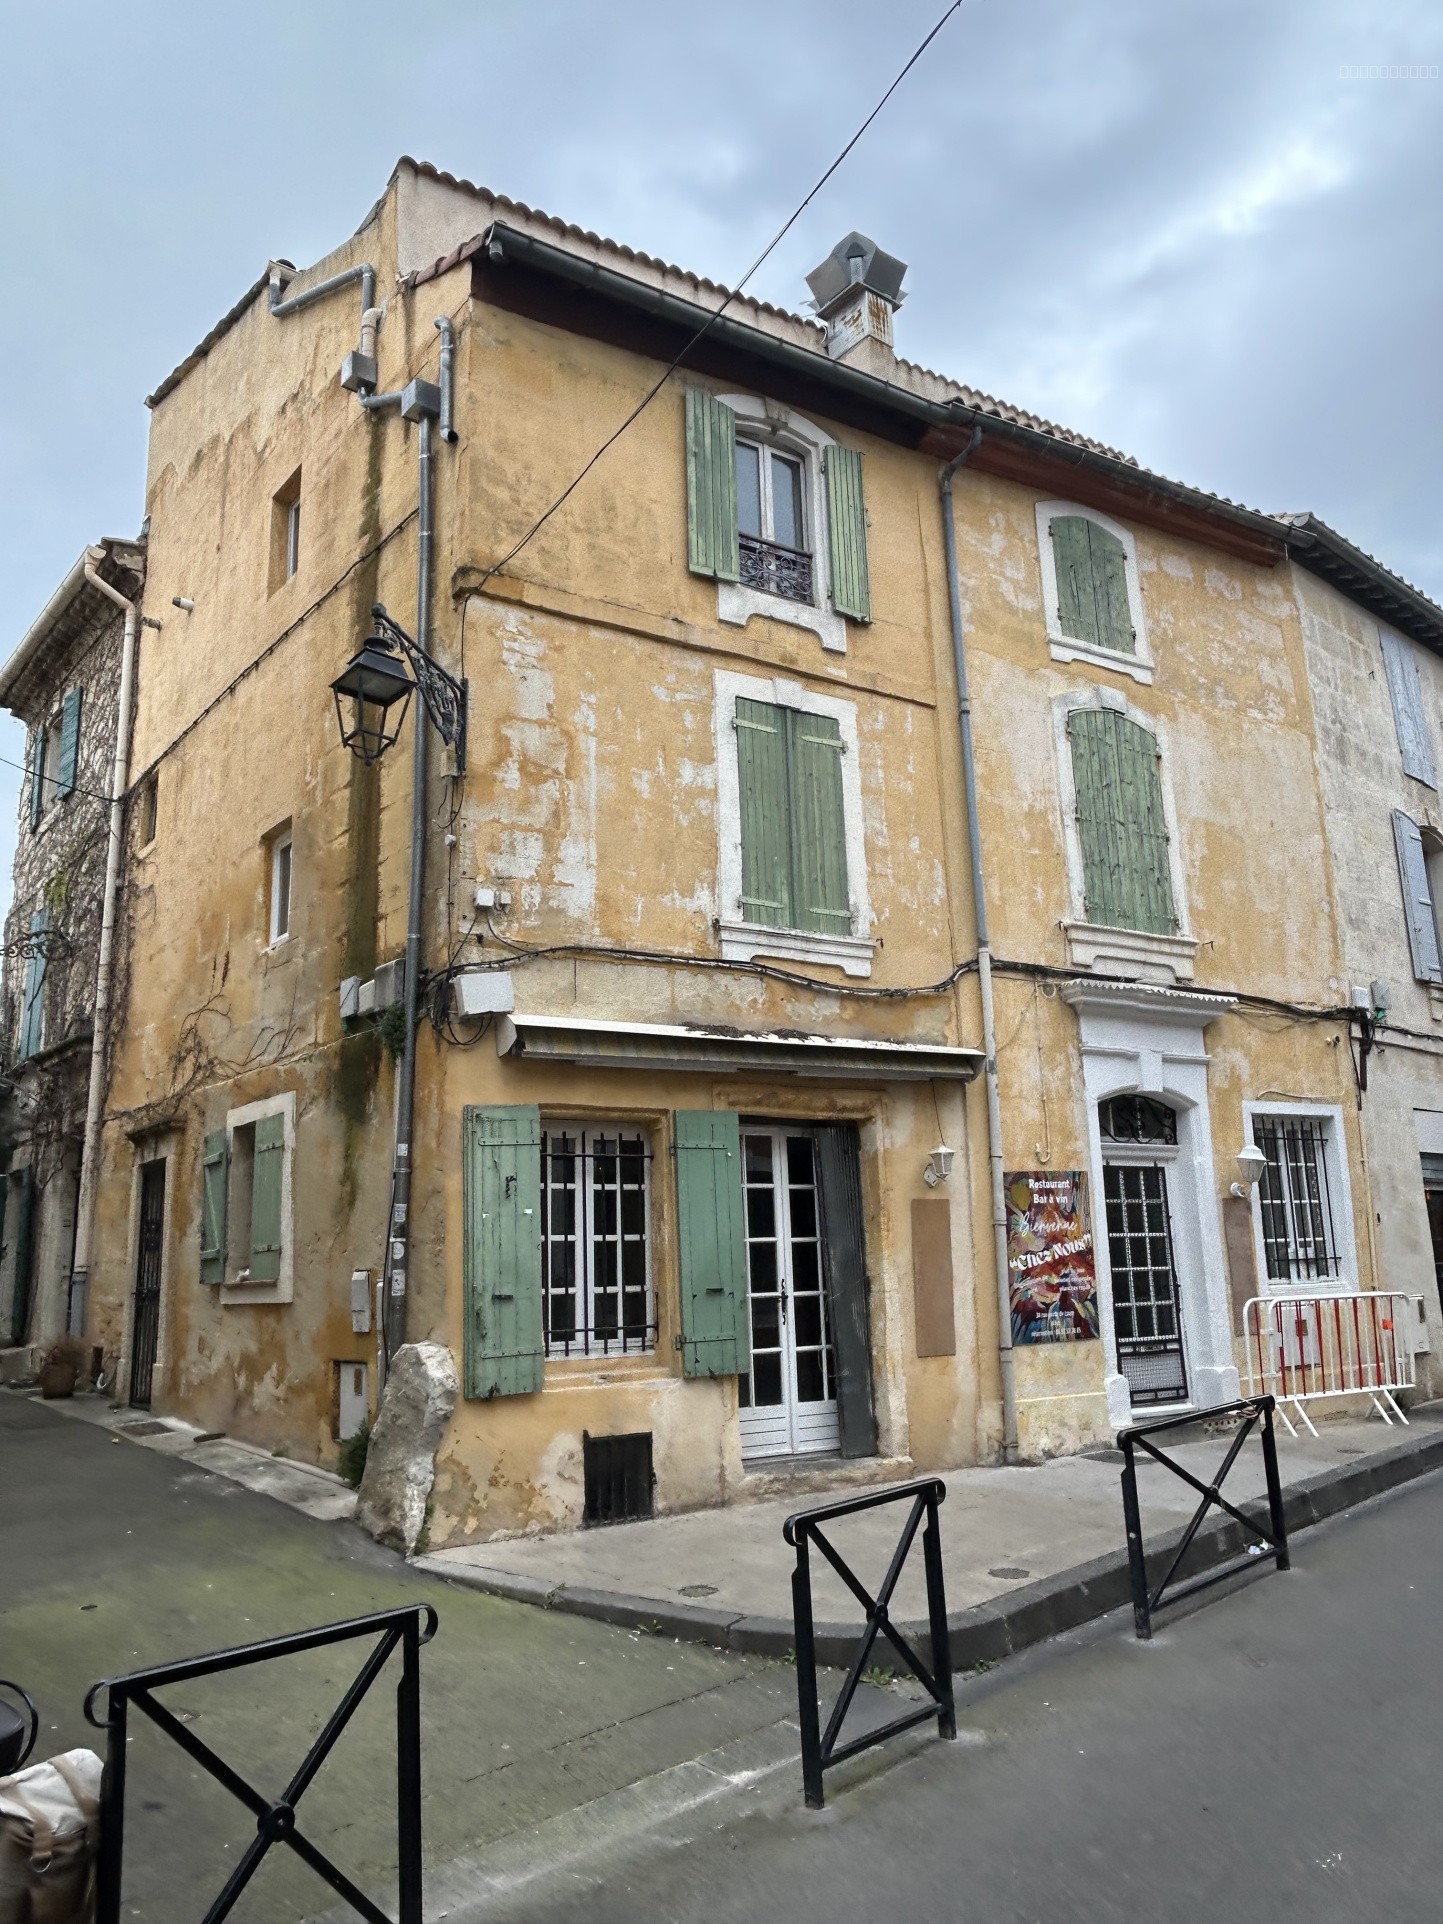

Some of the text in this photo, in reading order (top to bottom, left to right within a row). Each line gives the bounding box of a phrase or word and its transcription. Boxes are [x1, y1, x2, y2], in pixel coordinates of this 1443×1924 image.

[1028, 1179, 1070, 1189] Restaurant
[1033, 1194, 1048, 1204] Bar
[1056, 1194, 1068, 1204] vin
